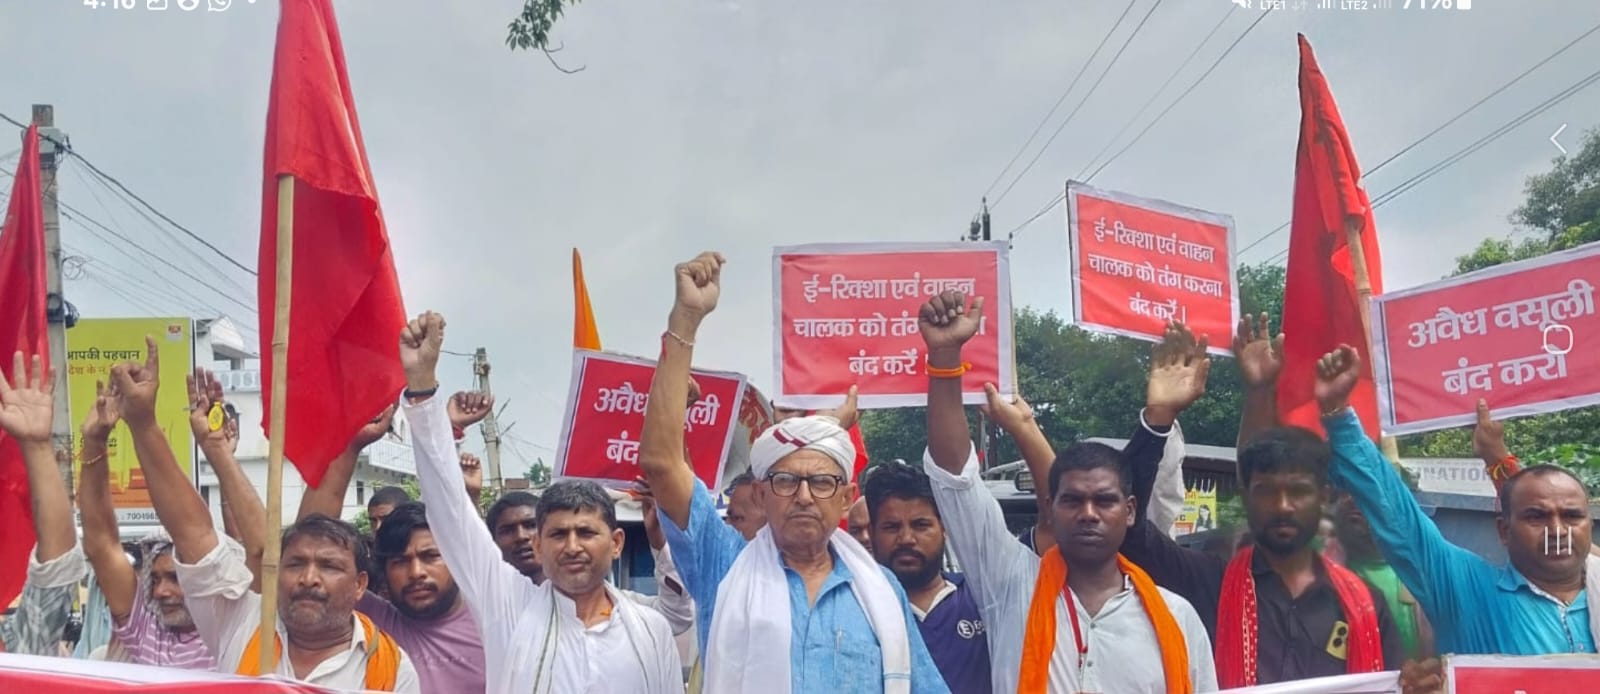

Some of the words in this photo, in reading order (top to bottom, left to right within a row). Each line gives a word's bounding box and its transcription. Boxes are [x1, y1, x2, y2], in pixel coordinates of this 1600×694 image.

[1094, 217, 1154, 250] ई-रिक्शा
[1156, 233, 1176, 254] एवं
[1179, 241, 1214, 263] वाहन
[802, 273, 887, 303] ई-रिक्शा
[890, 272, 920, 299] एवं
[1088, 253, 1133, 278] चालक
[1135, 261, 1155, 283] को
[1157, 264, 1182, 289] तंग
[1184, 275, 1223, 297] करना
[1129, 292, 1150, 316] बंद
[1408, 306, 1488, 348] अवैध
[1492, 279, 1595, 332] वसूली
[793, 318, 855, 338] चालक
[858, 312, 888, 337] को
[848, 350, 879, 376] बंद
[1441, 357, 1494, 395] बंद
[593, 381, 649, 417] अवैध
[606, 430, 641, 465] बंद
